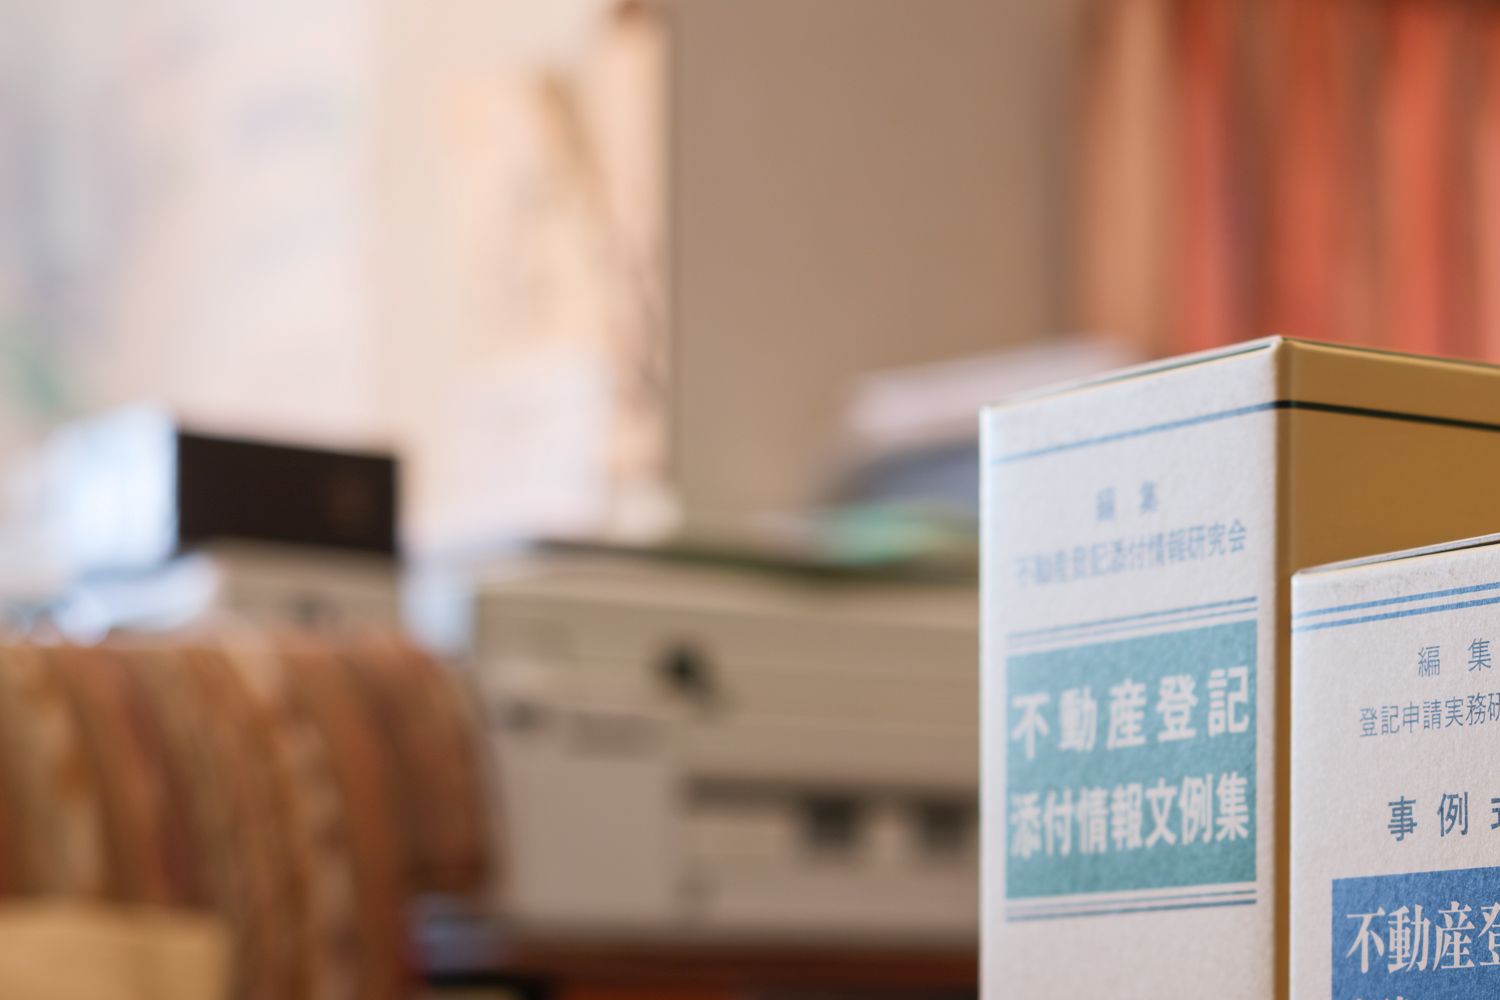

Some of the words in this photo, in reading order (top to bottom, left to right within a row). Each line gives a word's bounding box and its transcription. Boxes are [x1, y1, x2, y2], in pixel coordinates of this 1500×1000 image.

[1011, 666, 1250, 760] 不動産登記
[1010, 771, 1249, 860] 添付情報文例集
